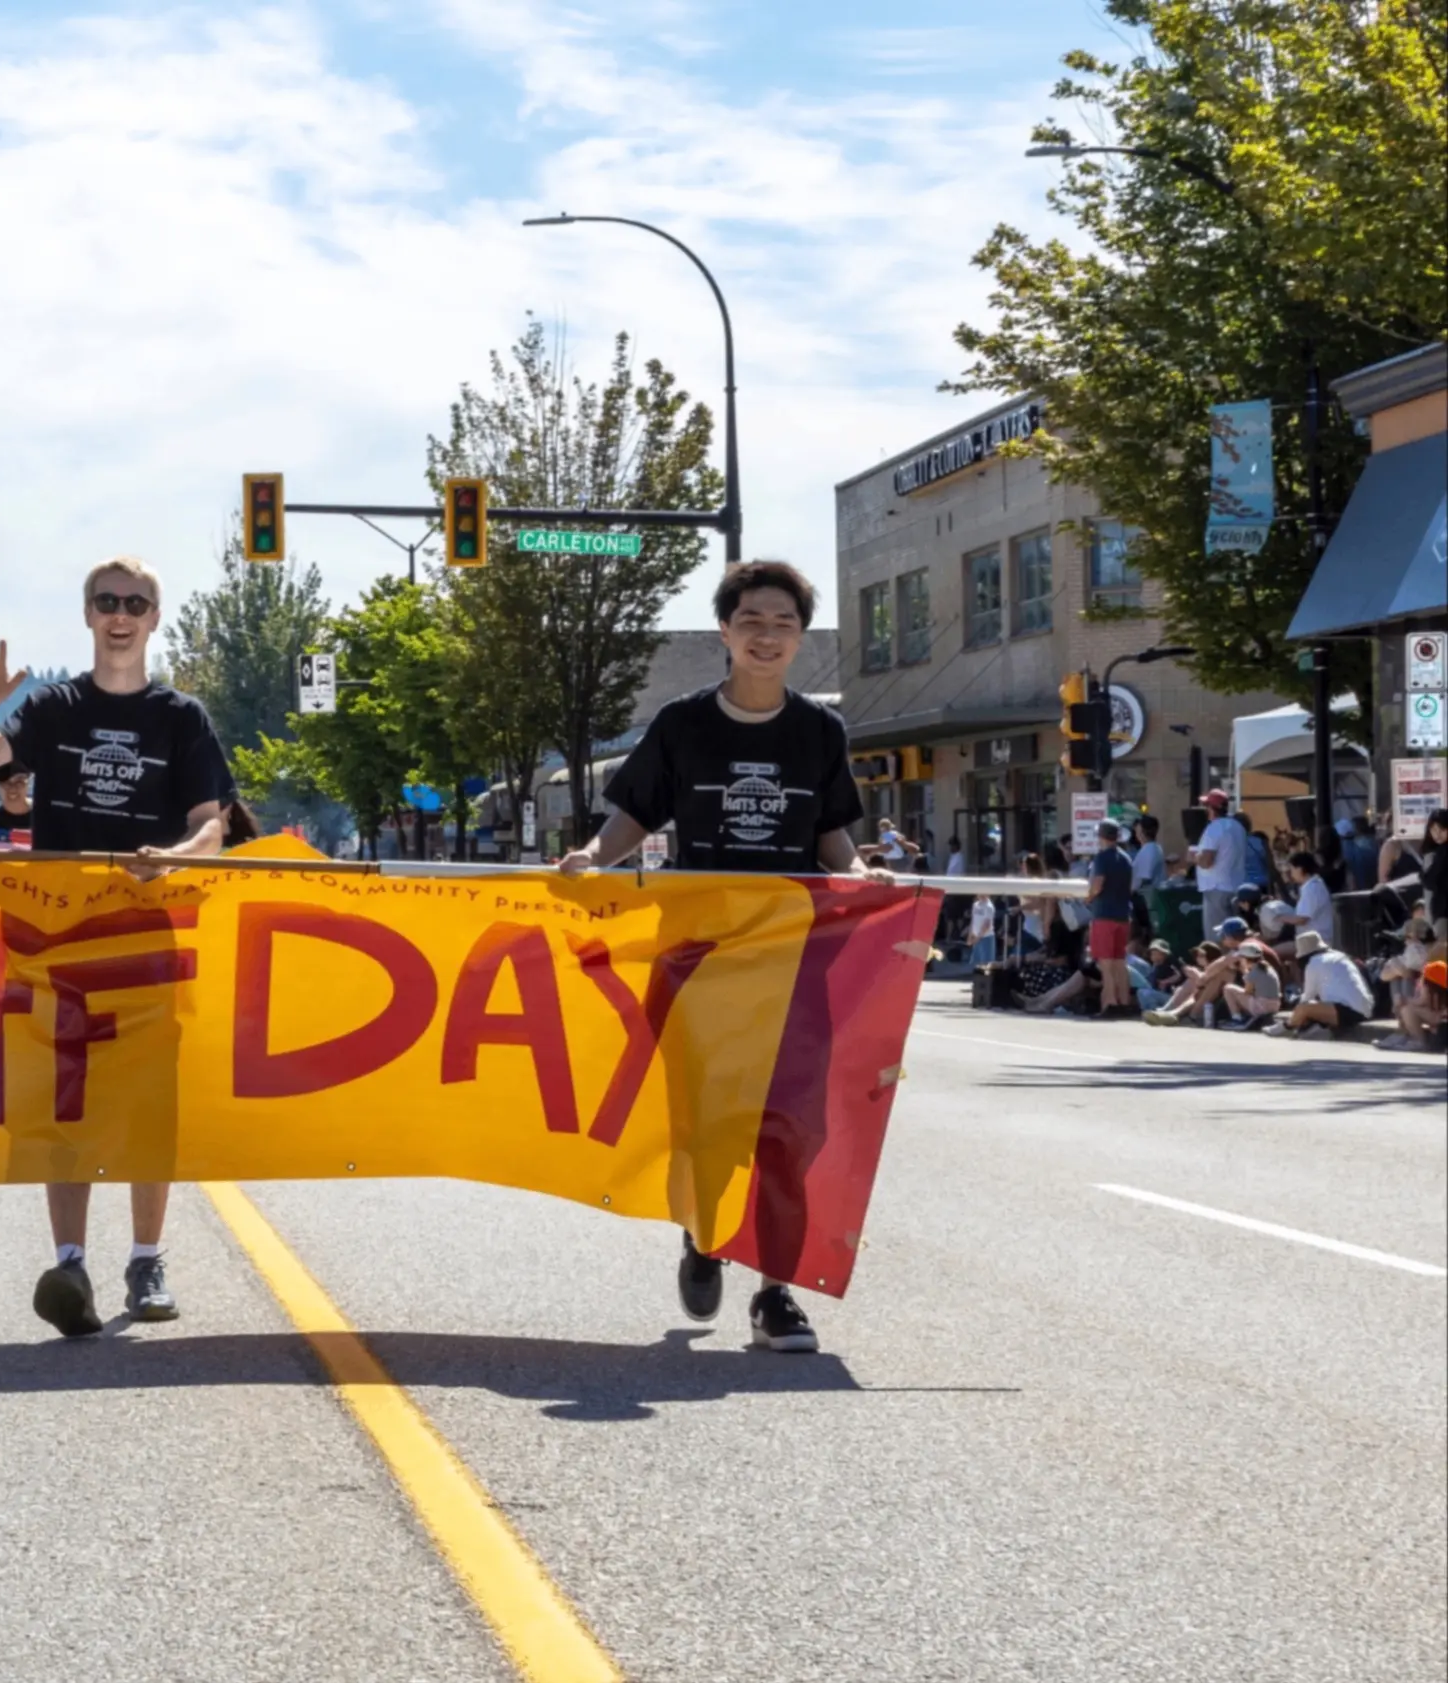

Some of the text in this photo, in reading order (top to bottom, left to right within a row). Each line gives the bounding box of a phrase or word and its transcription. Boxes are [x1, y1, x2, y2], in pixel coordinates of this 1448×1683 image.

[523, 532, 619, 553] CARLETON
[80, 760, 145, 781] HATS OFF
[722, 796, 789, 814] HATS OFF
[268, 870, 285, 881] &
[299, 870, 481, 901] COMMUNITY
[495, 895, 621, 923] PRESENT
[233, 901, 718, 1148] DAY
